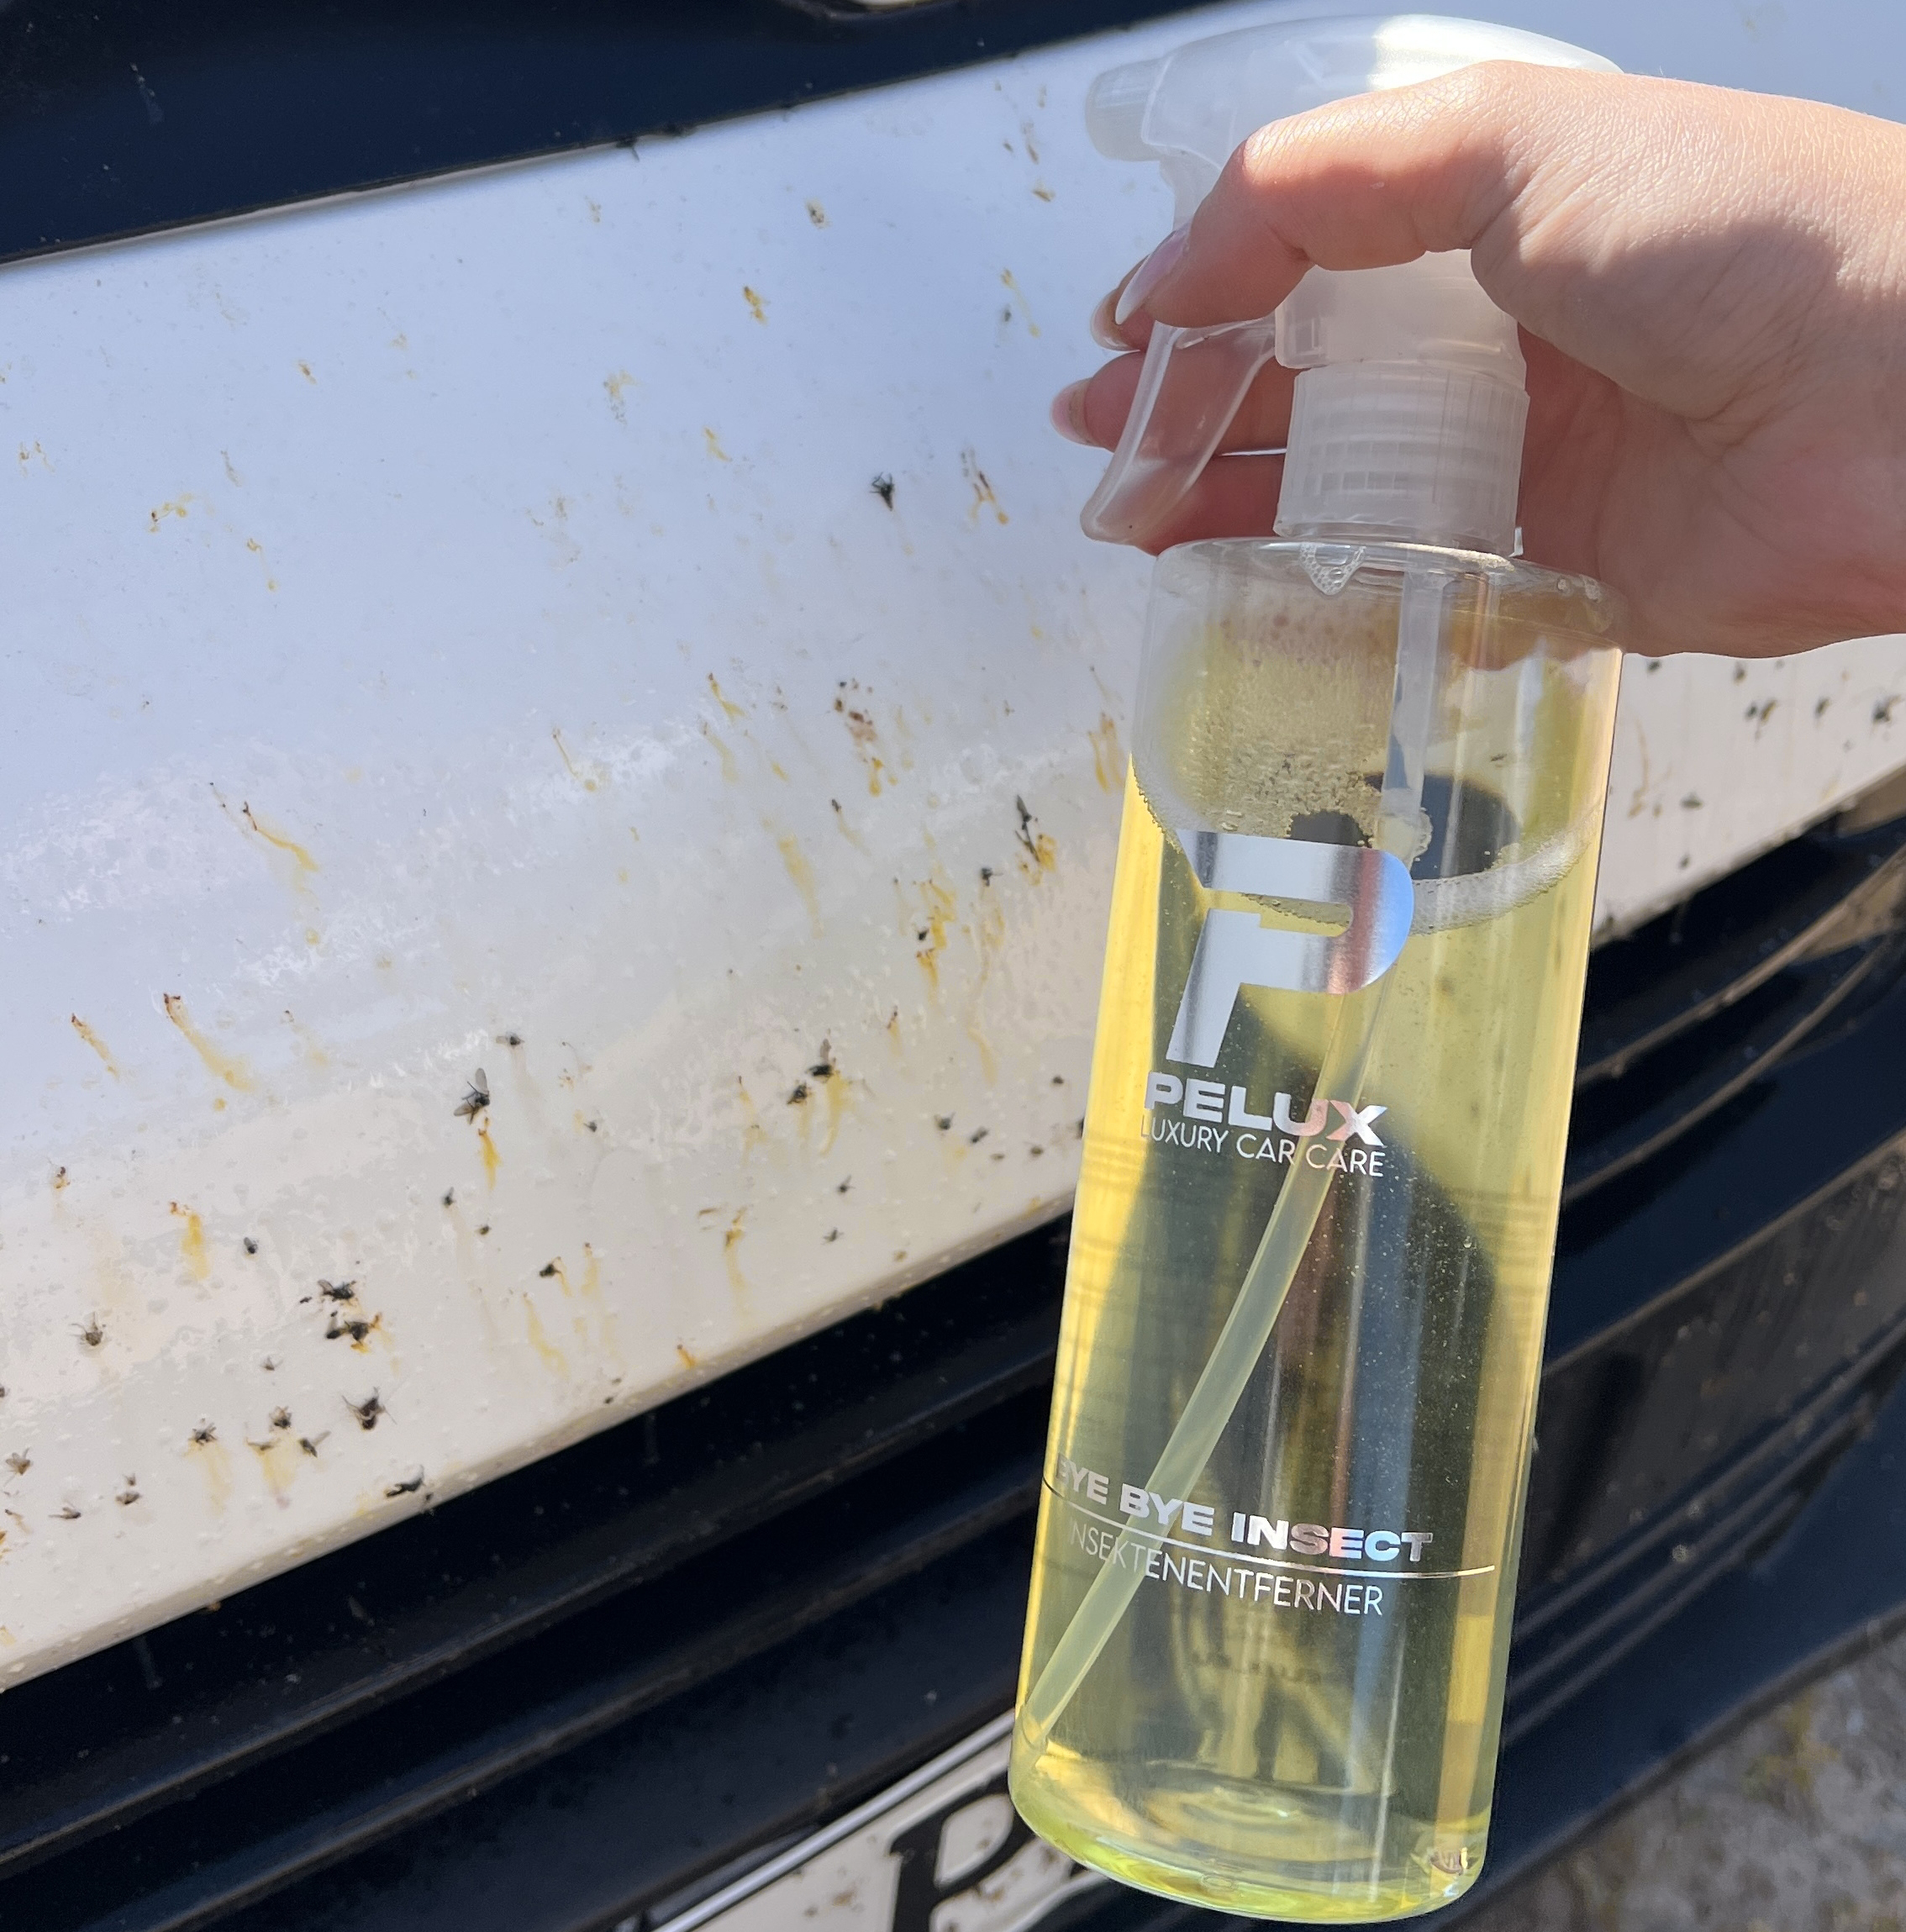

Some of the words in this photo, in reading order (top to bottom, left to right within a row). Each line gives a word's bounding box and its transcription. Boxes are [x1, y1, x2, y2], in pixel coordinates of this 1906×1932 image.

[1141, 1114, 1229, 1153] LUXURY
[1236, 1133, 1295, 1166] CAR
[1305, 1144, 1385, 1177] CARE
[1145, 1071, 1388, 1147] PELUX
[1056, 1453, 1109, 1505] BYE
[1119, 1482, 1215, 1545] BYE
[1231, 1512, 1434, 1562] INSECT
